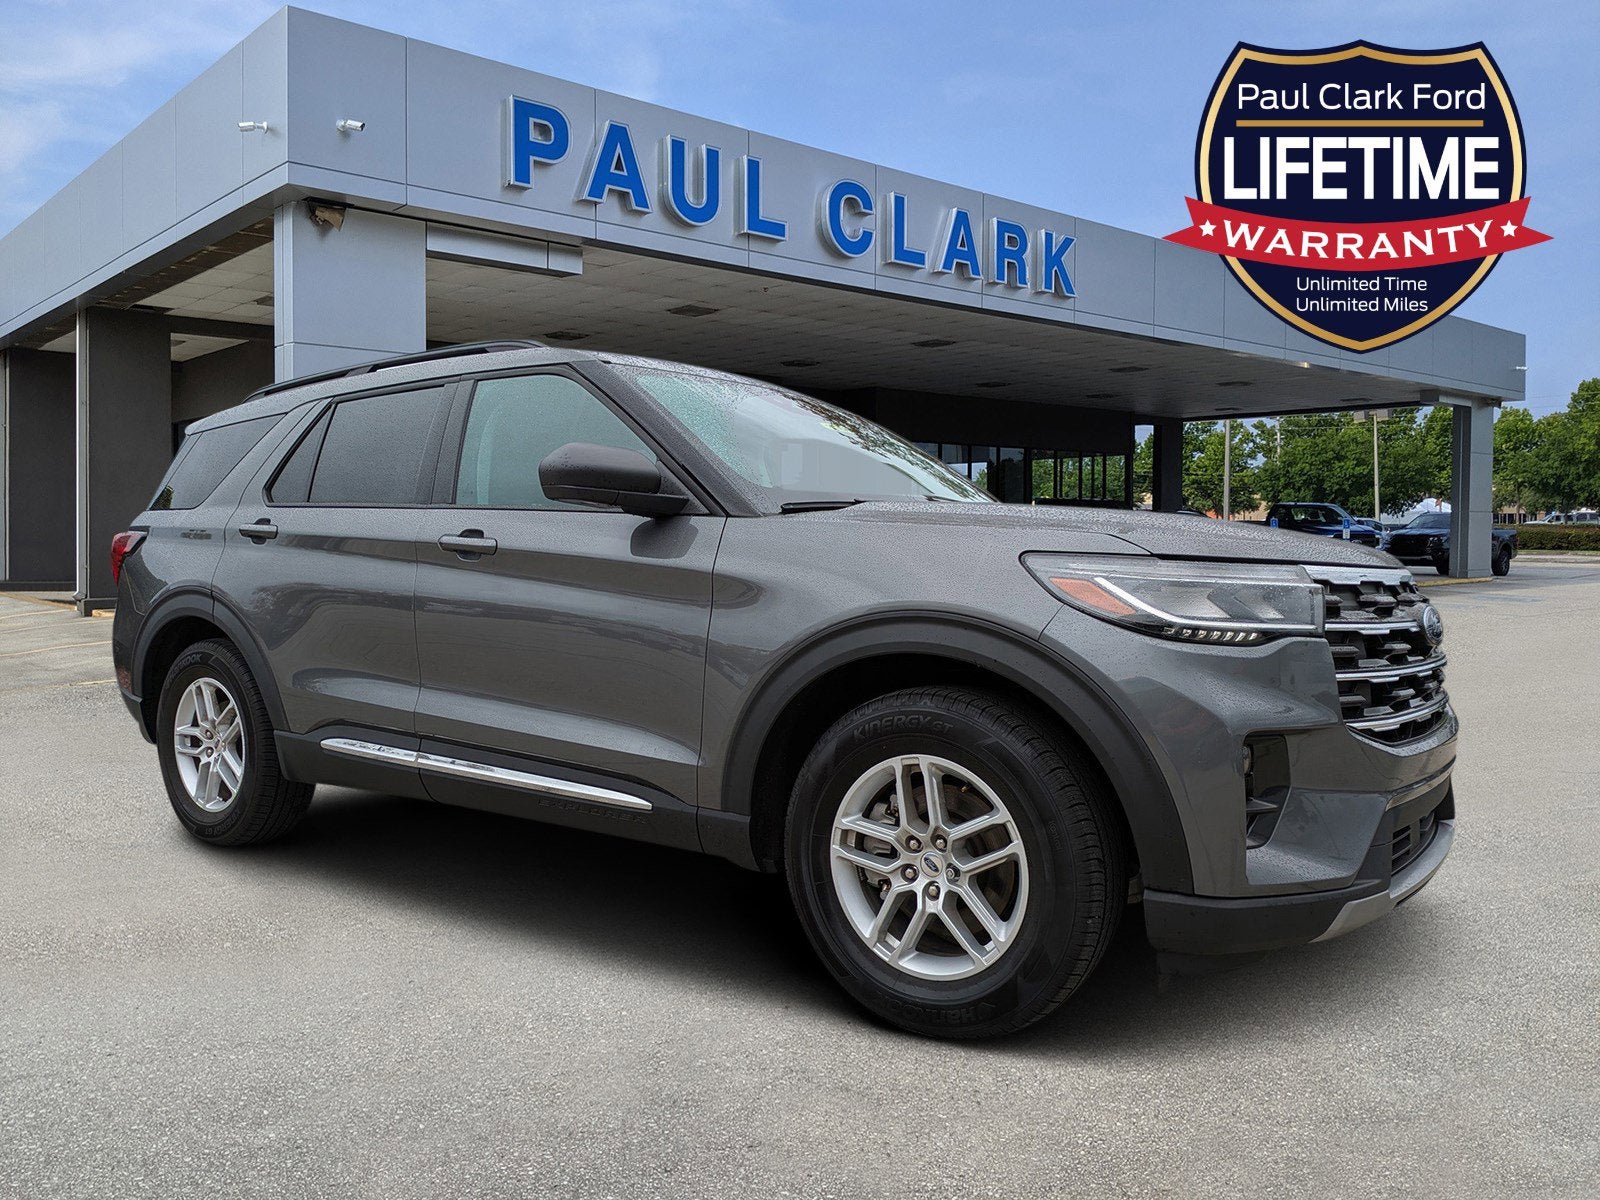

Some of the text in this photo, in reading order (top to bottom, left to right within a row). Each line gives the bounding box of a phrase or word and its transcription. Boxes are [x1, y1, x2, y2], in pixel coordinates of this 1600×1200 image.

[505, 95, 1077, 298] PAUL CLARK
[853, 714, 932, 741] KINERGY
